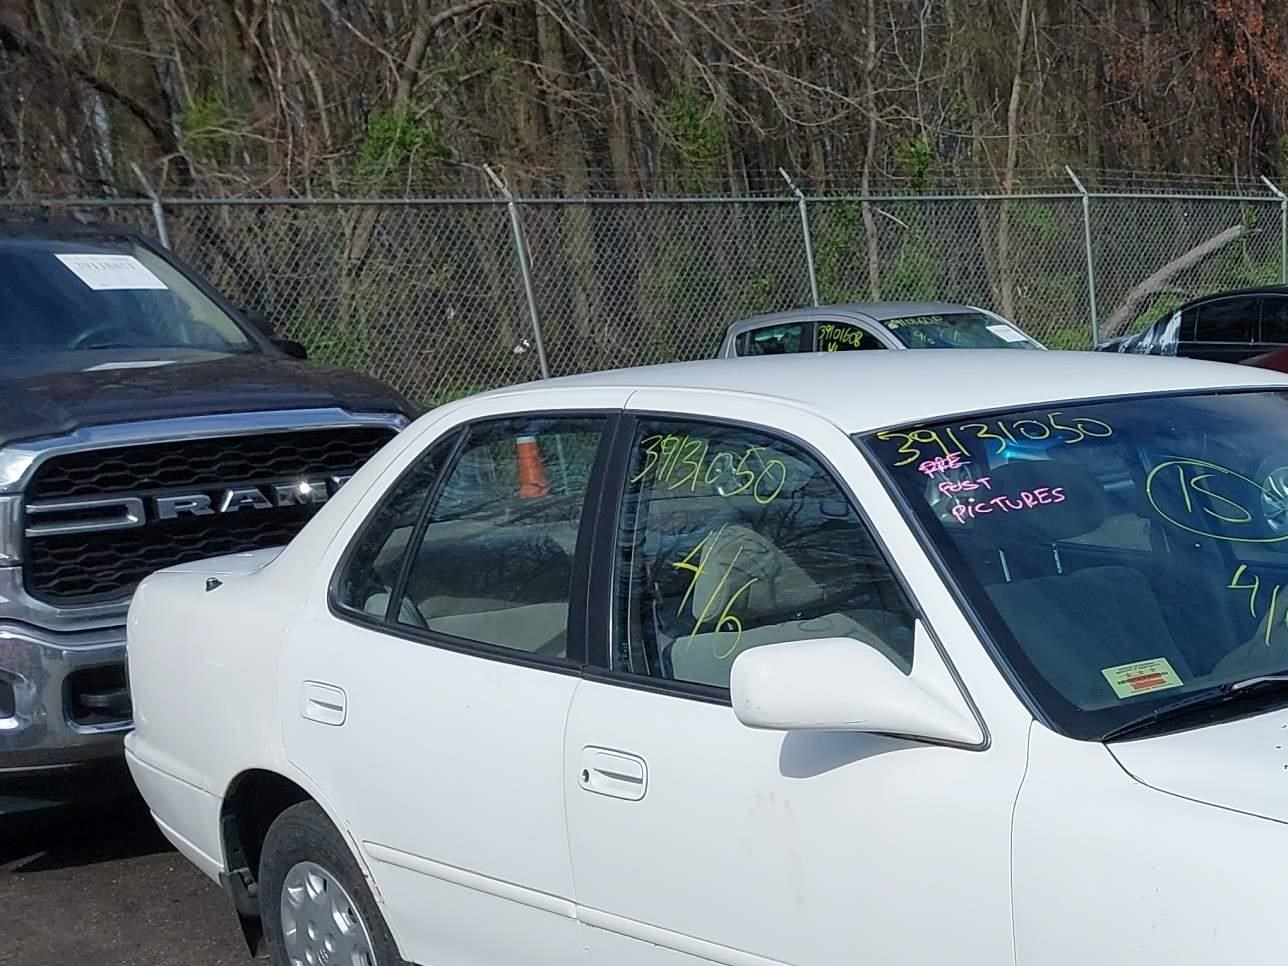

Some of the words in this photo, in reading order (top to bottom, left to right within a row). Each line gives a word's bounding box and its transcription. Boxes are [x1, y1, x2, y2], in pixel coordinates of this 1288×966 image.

[876, 412, 1113, 467] 39131050
[631, 434, 787, 504] 39131050
[938, 477, 993, 498] POST
[156, 480, 329, 520] RAM
[672, 521, 760, 660] 4/6
